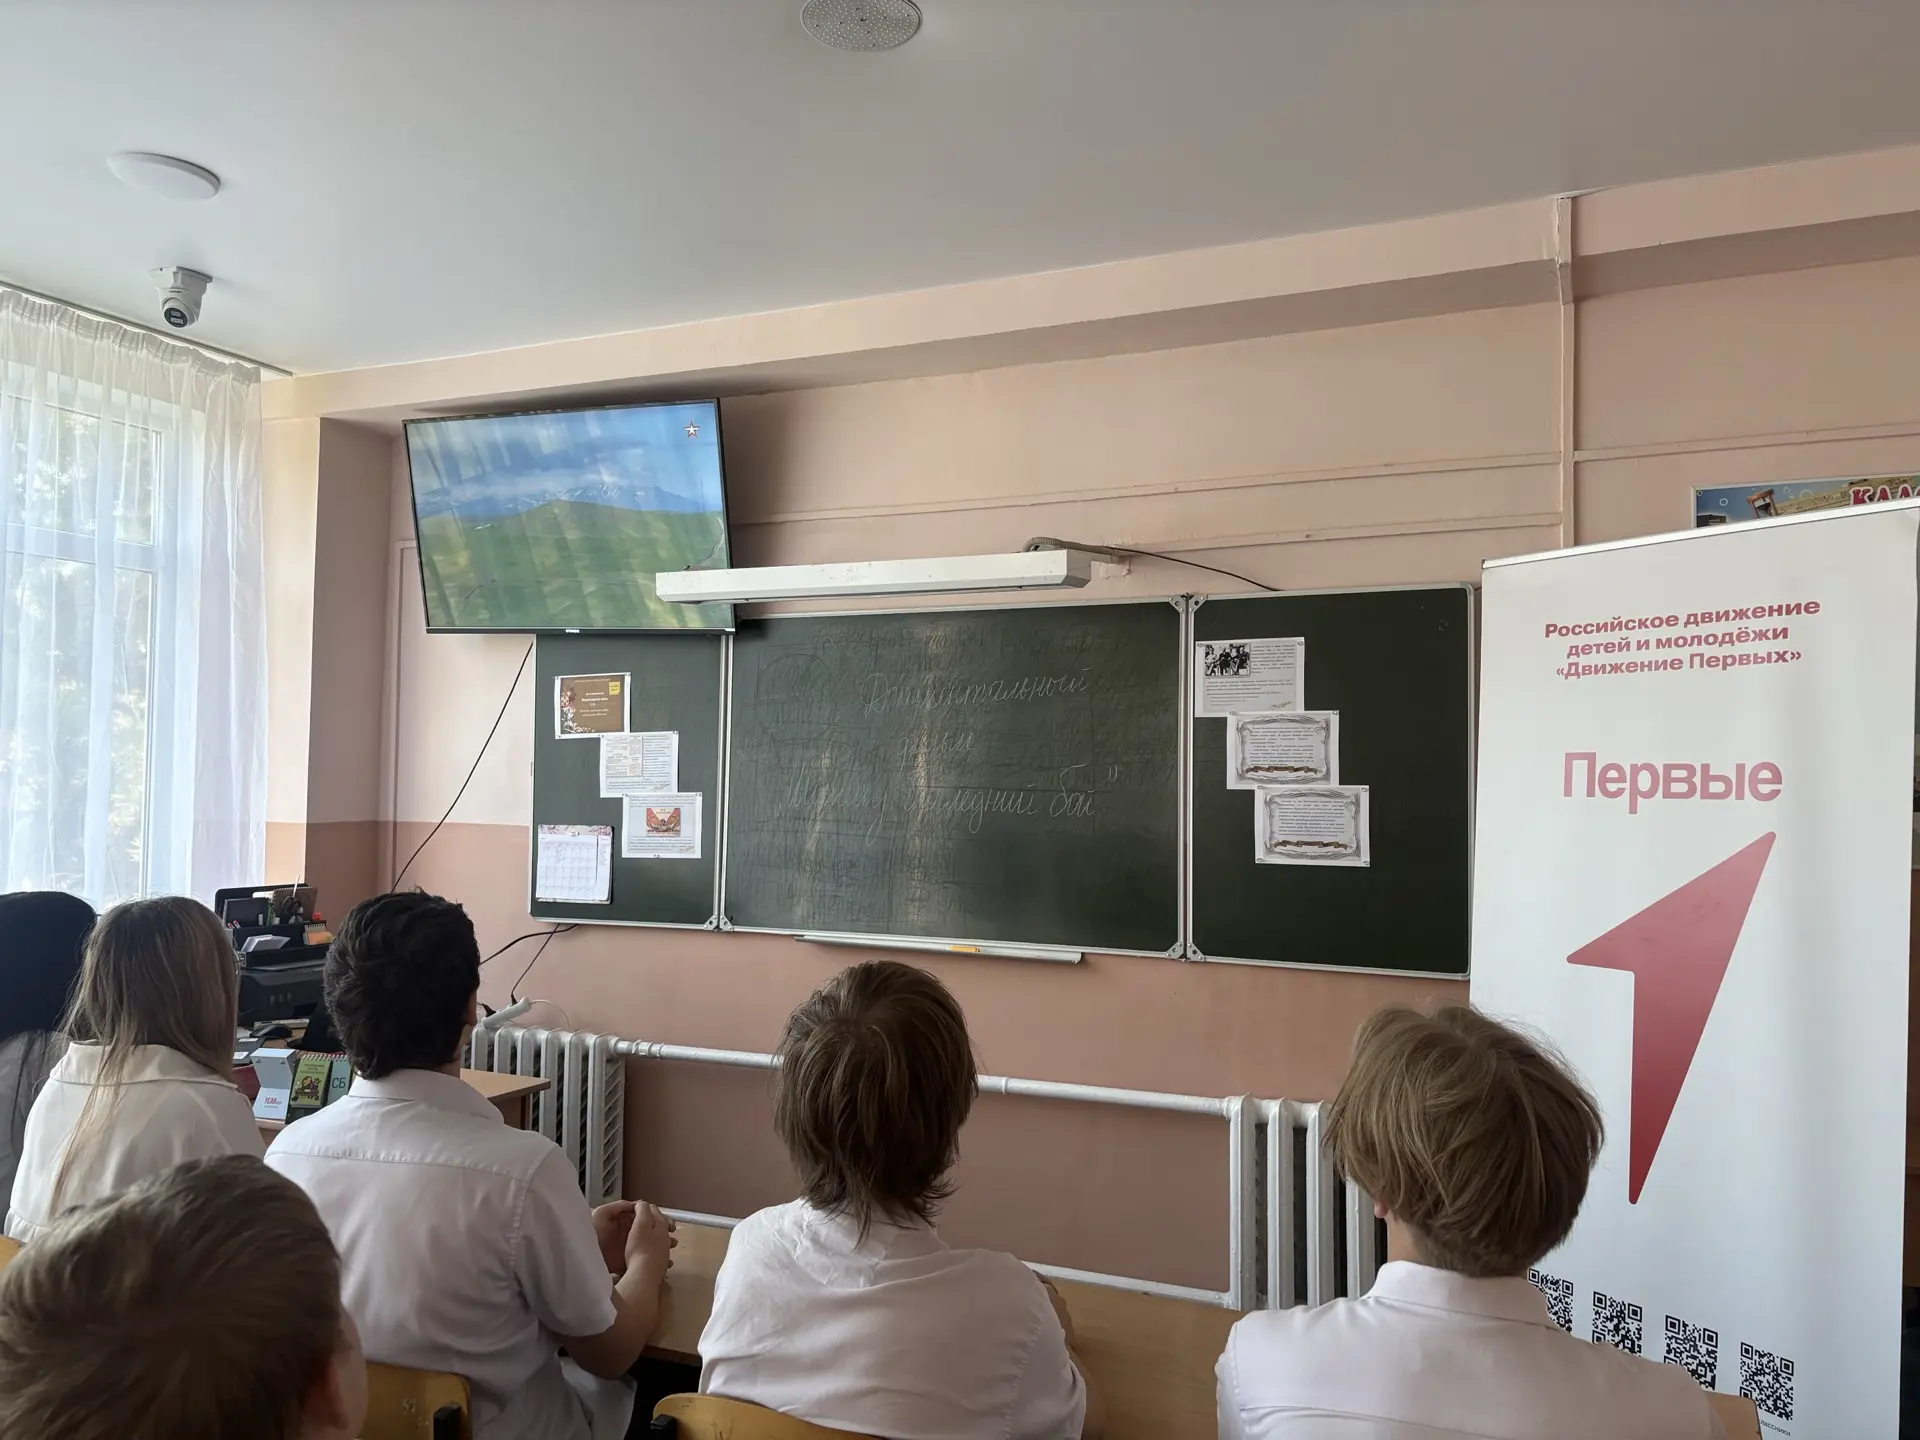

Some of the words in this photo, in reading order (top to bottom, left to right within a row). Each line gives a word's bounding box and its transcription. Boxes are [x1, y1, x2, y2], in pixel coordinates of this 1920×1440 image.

[1545, 614, 1679, 638] Российское
[1684, 600, 1821, 629] движение
[1567, 636, 1631, 658] детей
[1636, 638, 1650, 651] и
[1655, 626, 1789, 650] молодёжи
[1556, 658, 1683, 680] «Движение
[1689, 650, 1802, 670] Первых»
[1563, 752, 1783, 814] Первые
